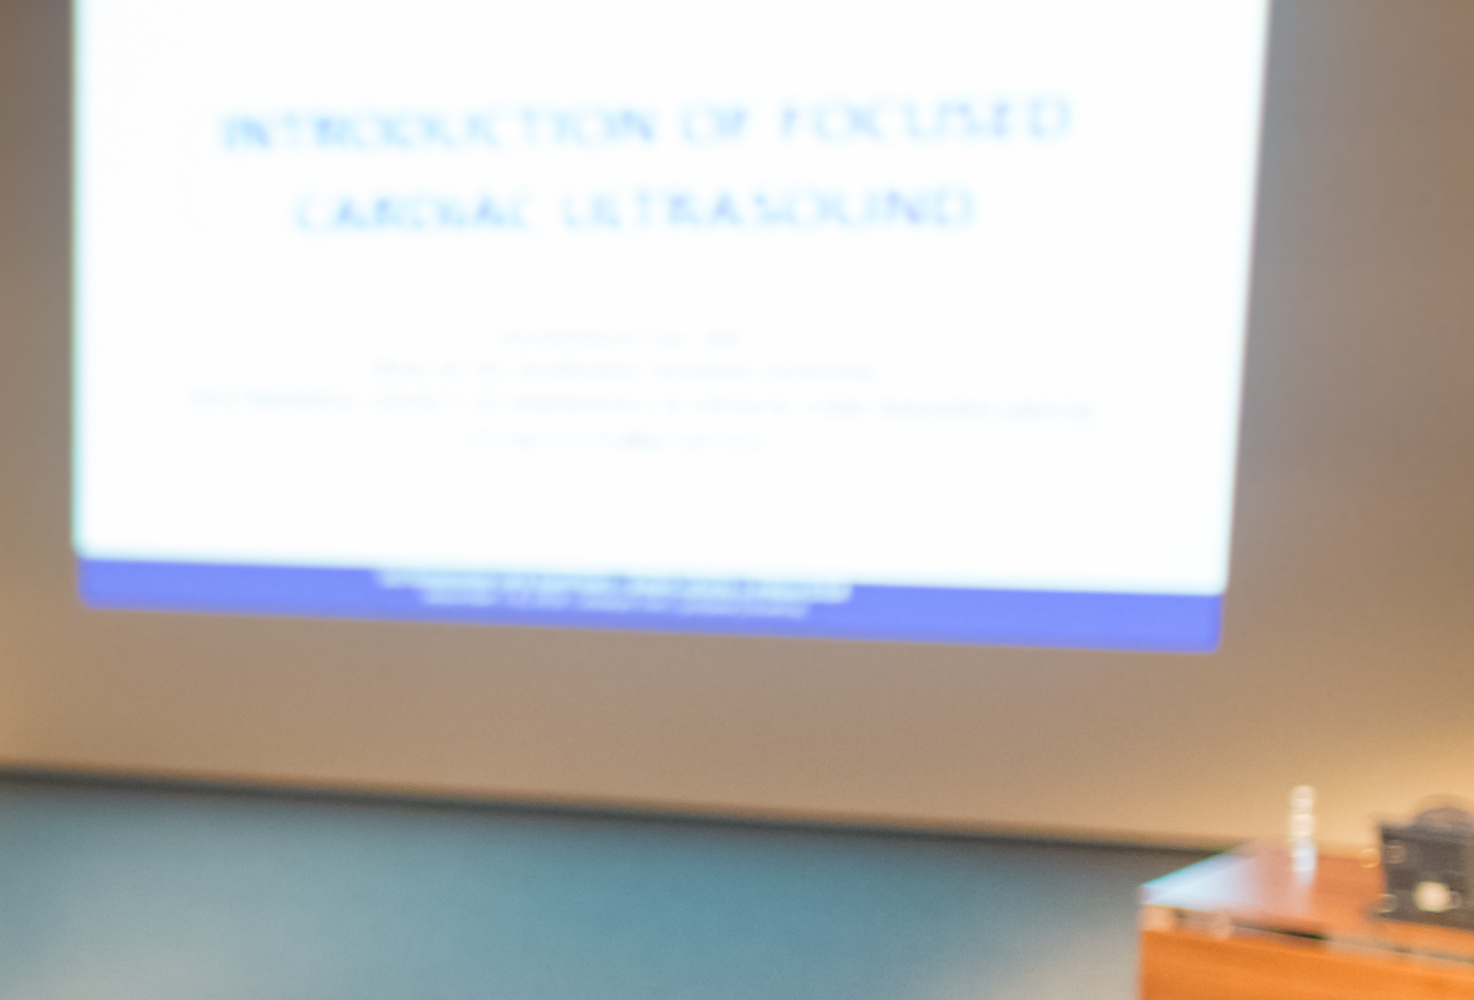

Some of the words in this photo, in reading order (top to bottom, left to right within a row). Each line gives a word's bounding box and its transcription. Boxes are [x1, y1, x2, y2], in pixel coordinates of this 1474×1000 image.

[219, 104, 659, 153] INTRODUCTION
[679, 102, 752, 145] OF
[777, 95, 1074, 141] FOCUSED
[292, 191, 527, 233] CARDIAC
[560, 185, 976, 231] ULTRASOUND
